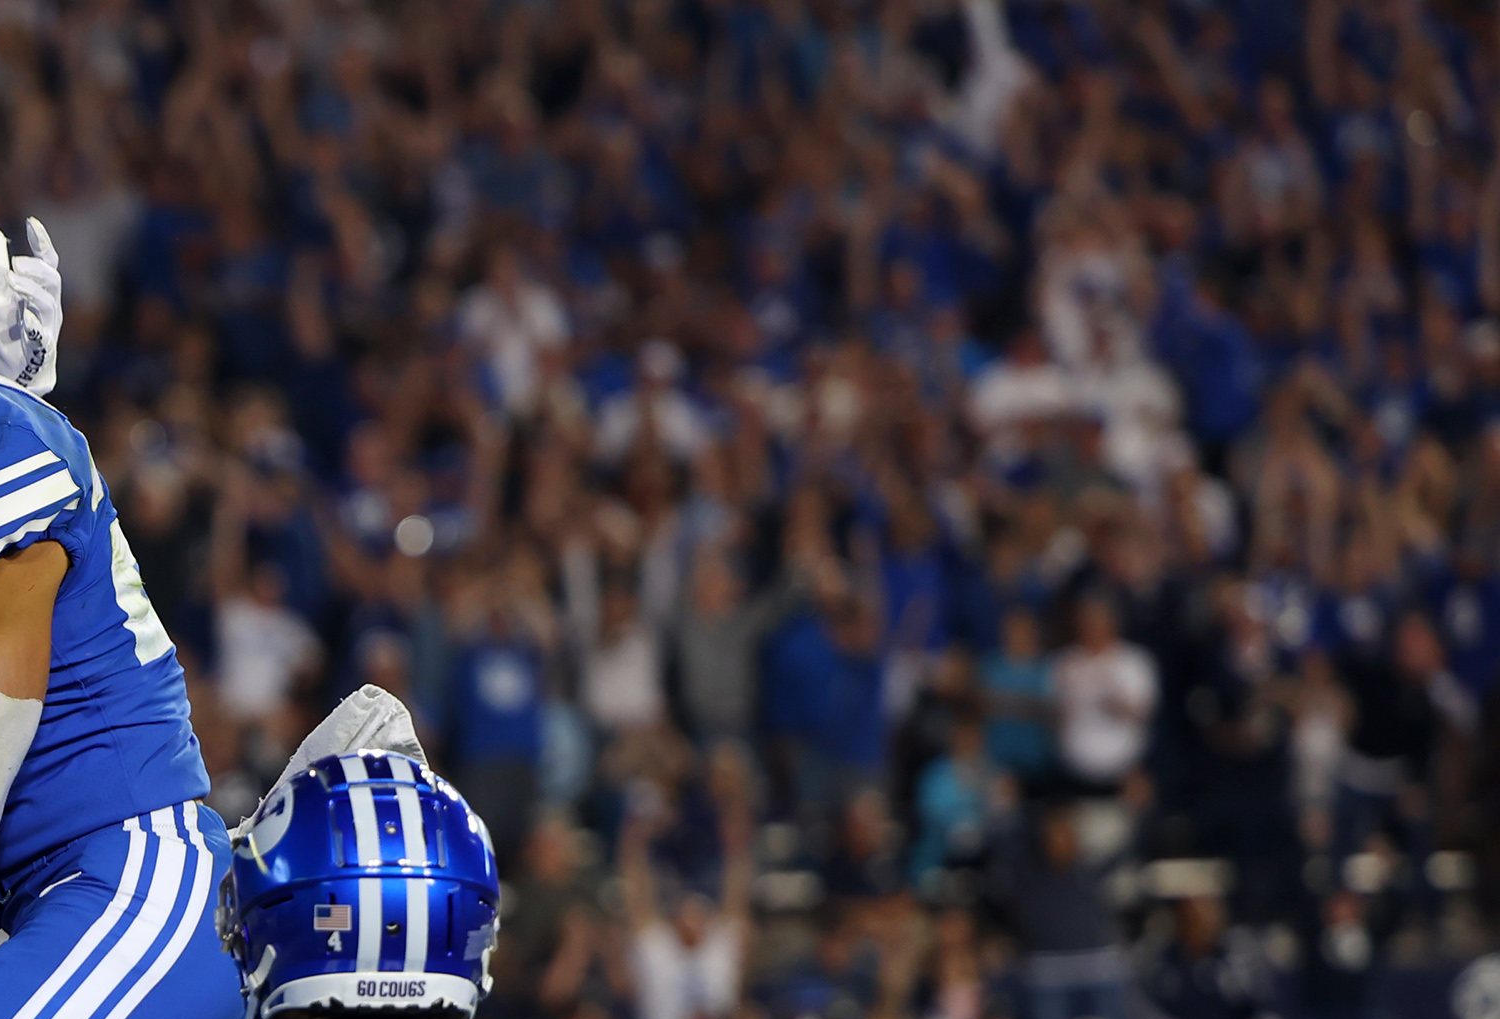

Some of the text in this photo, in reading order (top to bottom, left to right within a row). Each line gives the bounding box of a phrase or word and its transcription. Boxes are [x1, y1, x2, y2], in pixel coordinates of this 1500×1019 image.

[328, 931, 342, 952] 4
[358, 981, 426, 998] GO COUGS
